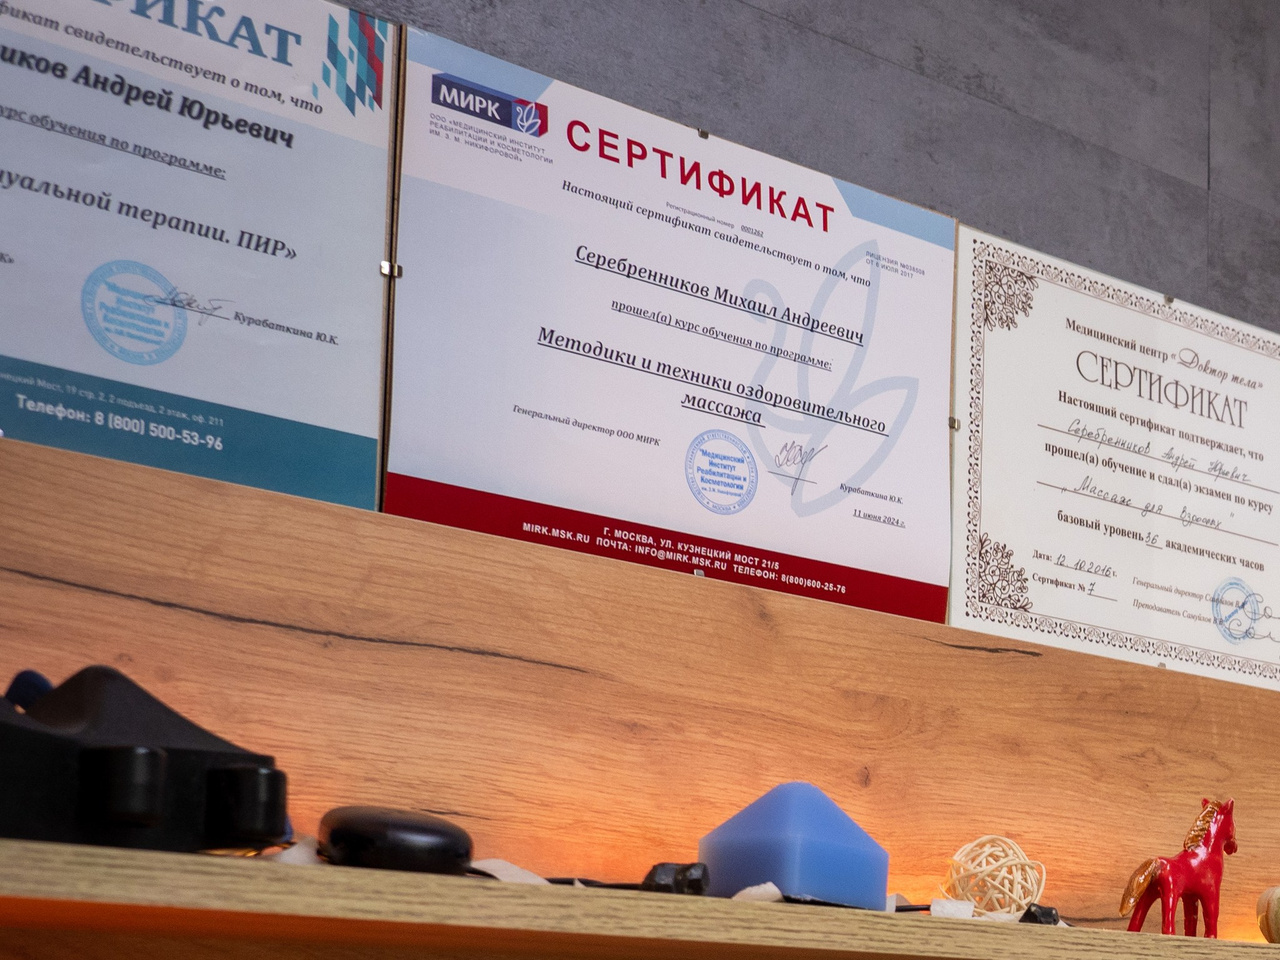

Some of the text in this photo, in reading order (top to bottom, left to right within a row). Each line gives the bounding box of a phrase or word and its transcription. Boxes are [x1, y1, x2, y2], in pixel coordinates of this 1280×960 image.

[93, 0, 302, 67] ИКАТ
[64, 24, 324, 116] свидетельствует о том, что
[72, 64, 173, 112] Андрей
[178, 95, 295, 149] Юрьевич
[439, 83, 501, 120] МИРК
[29, 113, 107, 146] обучения
[110, 135, 129, 152] по
[132, 142, 227, 181] программе:
[429, 121, 488, 144] РЕАБИЛИТАЦИИ
[497, 142, 553, 164] КОСМЕТОЛОГИИ
[509, 137, 545, 153] ИНСТИТУТ
[566, 119, 835, 233] СЕРТИФИКАТ
[0, 168, 298, 260] уальной терапии. ПИР»
[562, 179, 871, 288] Настоящий сертификат свидетельствует о том, что
[575, 245, 864, 347] Серебренников Михаил Андреевич
[233, 310, 340, 346] Курабаткина Ю.К.
[610, 299, 833, 369] прошел(а) курс обучения по программе:
[1065, 317, 1169, 363] Медицинский центр
[537, 326, 890, 437] Методики техники оздоровительного
[681, 393, 766, 428] массажа
[1076, 350, 1248, 429] СЕРТИФИКАТ
[15, 392, 91, 423] Телефон:
[94, 411, 105, 426] 8
[108, 413, 145, 435] (800)
[149, 422, 224, 451] 500-53-96
[512, 404, 661, 447] Генеральный директор ООО МИРК
[1058, 390, 1264, 462] Настоящий сертификат подтверждает, что
[839, 483, 888, 502] Курабаткина
[1044, 442, 1274, 515] прошел(а) обучение сдал(а) экзамен по курсу
[522, 522, 590, 545] MIRK.MSK.RU
[595, 537, 633, 553] ПОЧТА:
[635, 544, 727, 571] INFO@MIRK.MSK.RU
[732, 564, 779, 582] ТЕЛЕФОН:
[603, 526, 780, 570] Г. МОСКВА, УЛ. КУЗНЕЦКИЙ МОСТ 21/5
[1032, 549, 1053, 562] Дата:
[1057, 509, 1265, 573] базовый уровень академических часов
[1032, 572, 1076, 593] Сертификат
[1132, 576, 1173, 594] Генеральный
